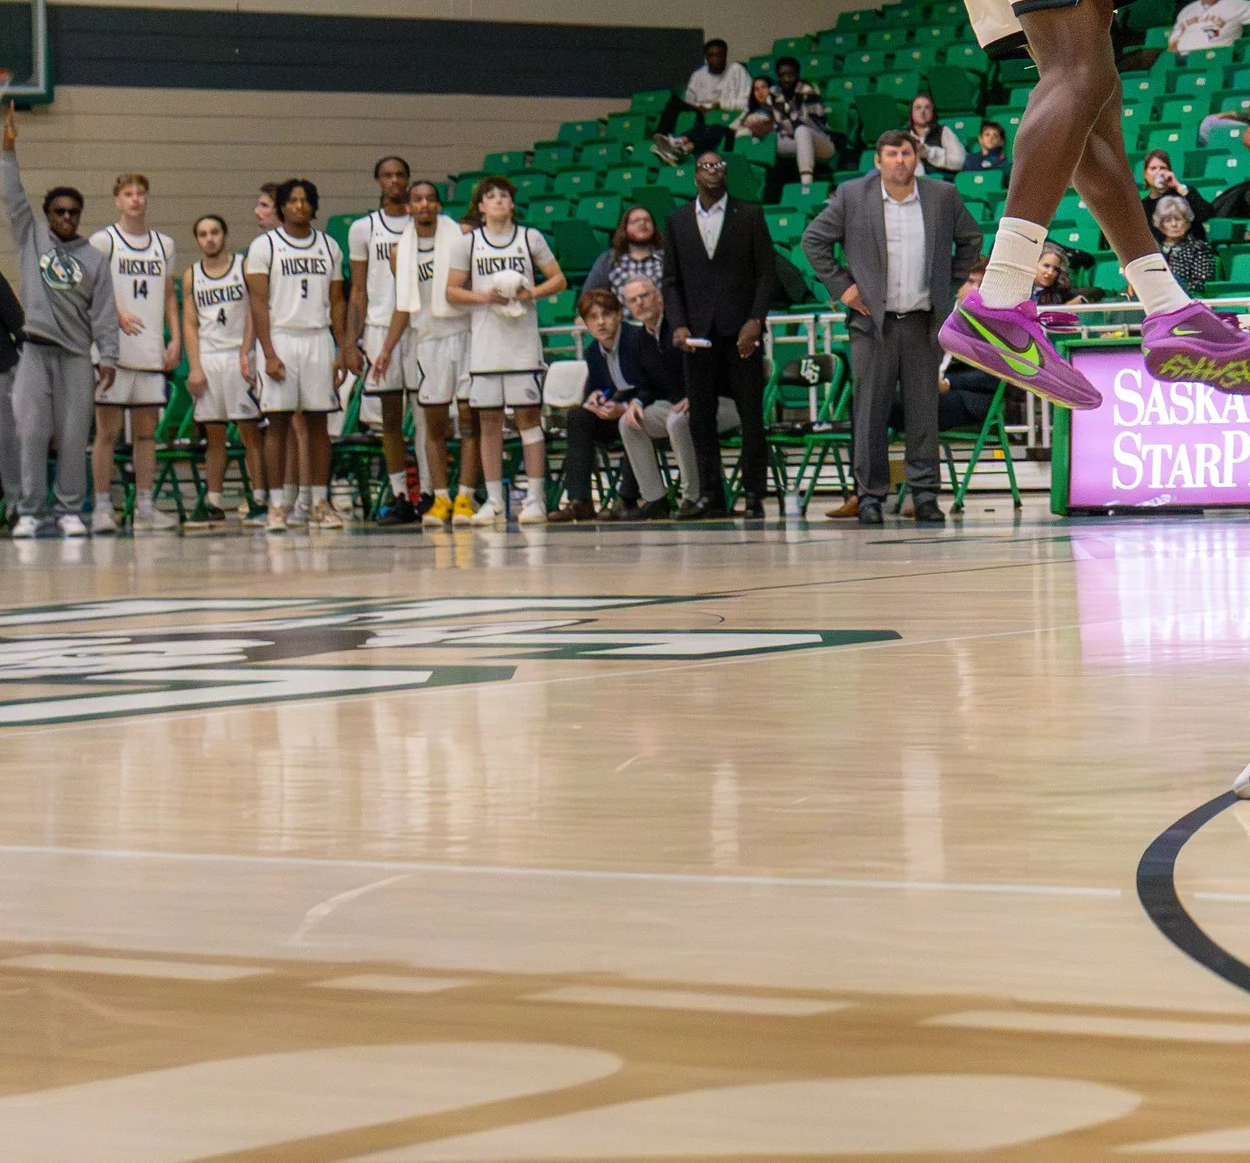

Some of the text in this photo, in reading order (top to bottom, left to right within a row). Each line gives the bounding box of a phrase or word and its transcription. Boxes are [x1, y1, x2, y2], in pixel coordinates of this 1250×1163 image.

[119, 258, 163, 277] HUSKIES
[281, 257, 327, 277] HUSKIES
[476, 256, 528, 277] HUSKIES
[133, 279, 148, 300] 14
[197, 283, 244, 308] HUSKIES
[216, 308, 227, 326] 4
